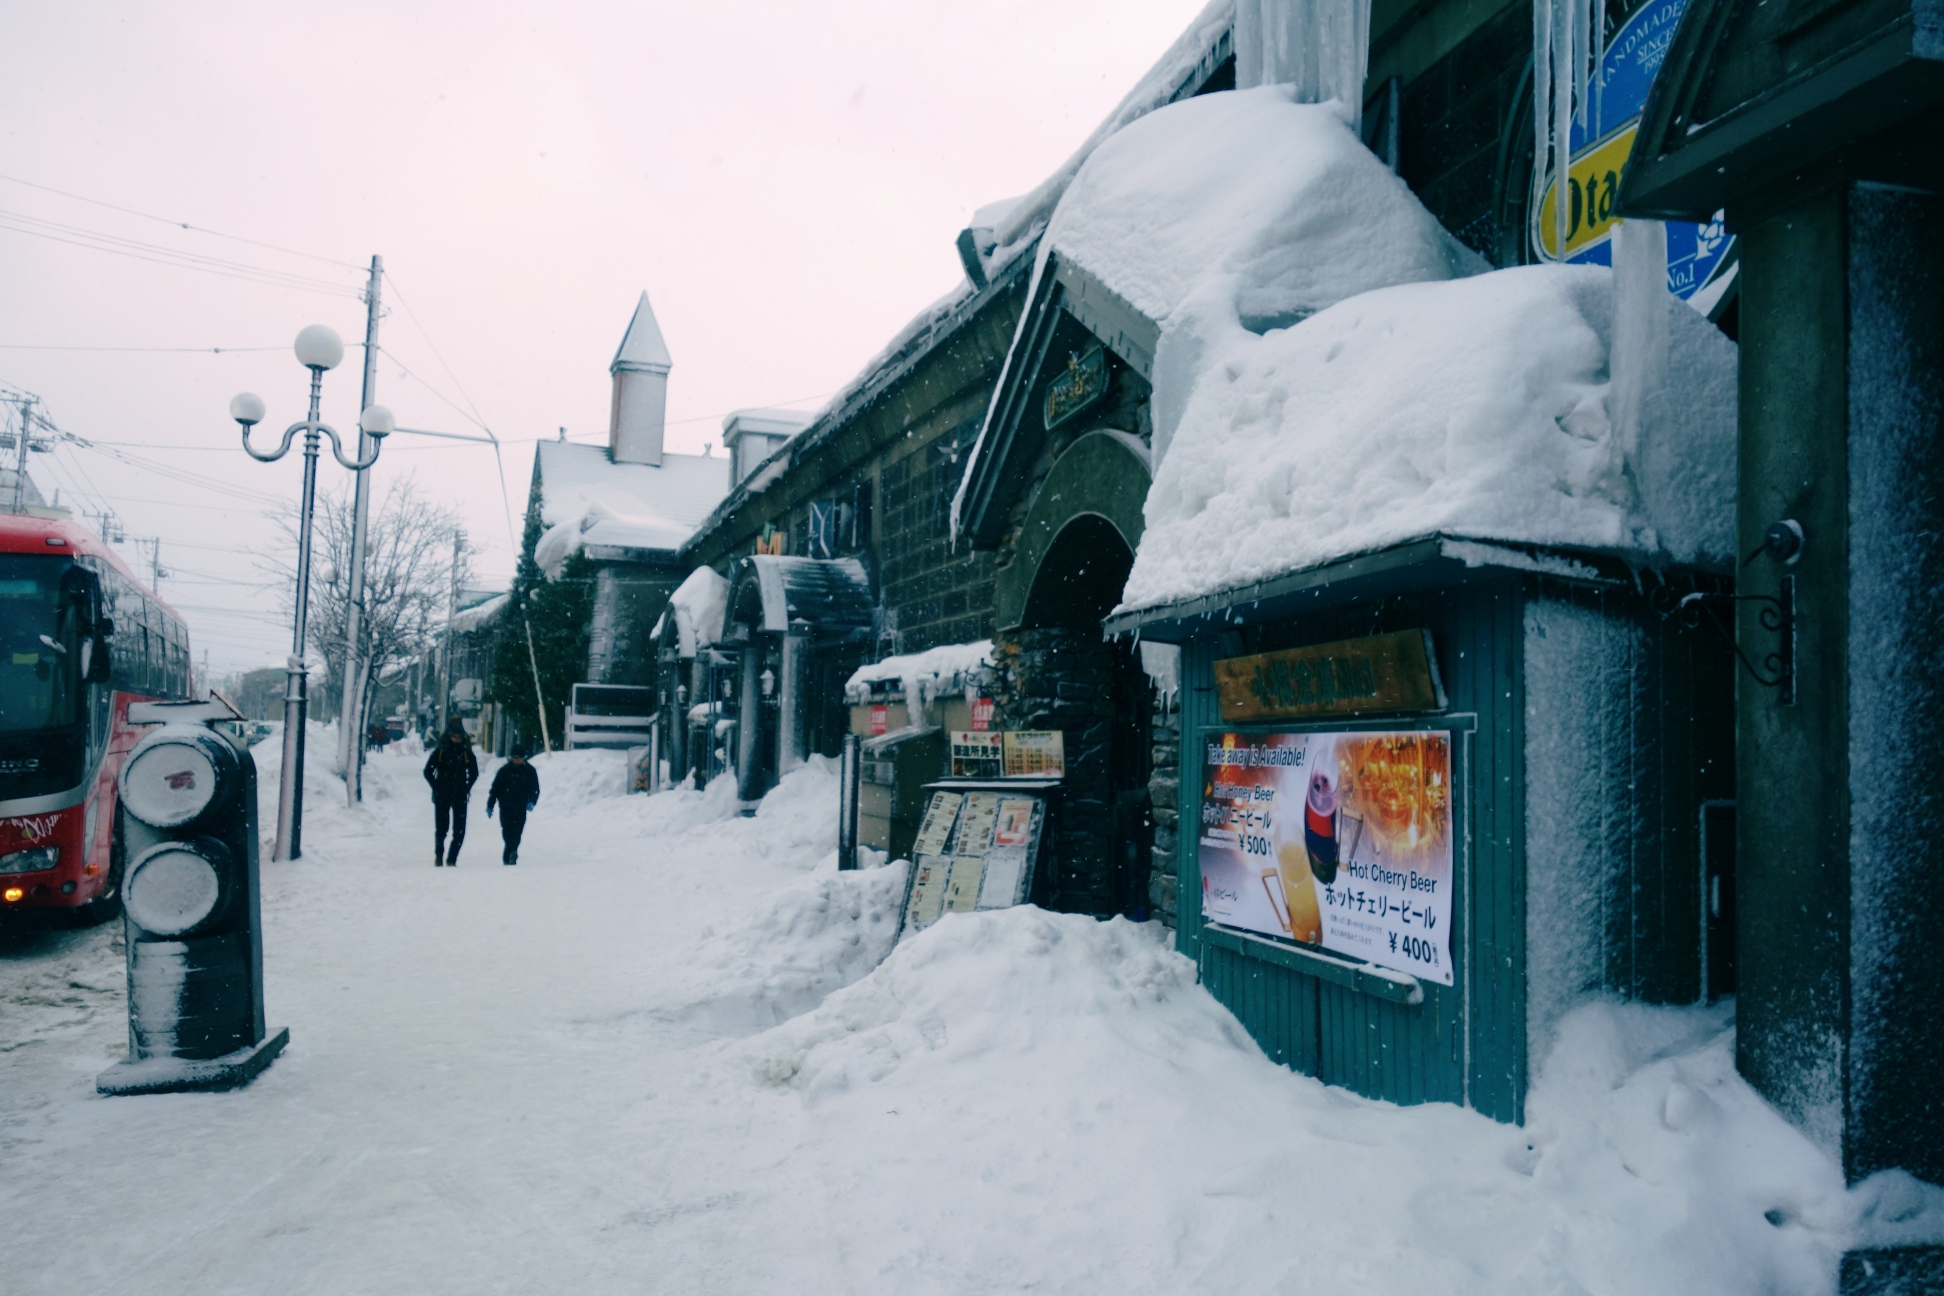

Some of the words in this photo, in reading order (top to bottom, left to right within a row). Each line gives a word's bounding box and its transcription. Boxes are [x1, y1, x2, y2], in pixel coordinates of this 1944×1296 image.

[1601, 4, 1683, 87] ANDMADE
[1637, 28, 1673, 61] SINCE
[1555, 168, 1624, 241] Ota
[1667, 263, 1694, 289] No.1
[0, 758, 39, 768] INO
[1207, 744, 1226, 765] Take
[1227, 748, 1249, 770] away
[1249, 744, 1259, 766] is
[1259, 745, 1306, 767] Available!
[1213, 781, 1227, 798] Hot
[1228, 782, 1252, 802] Honey
[1254, 785, 1275, 801] Beer
[1203, 802, 1272, 829] ホットハニービール
[1348, 860, 1369, 880] Hot
[1371, 863, 1408, 891] Cherry
[1410, 870, 1437, 893] Beer
[1325, 882, 1437, 929] ホットチェリービール
